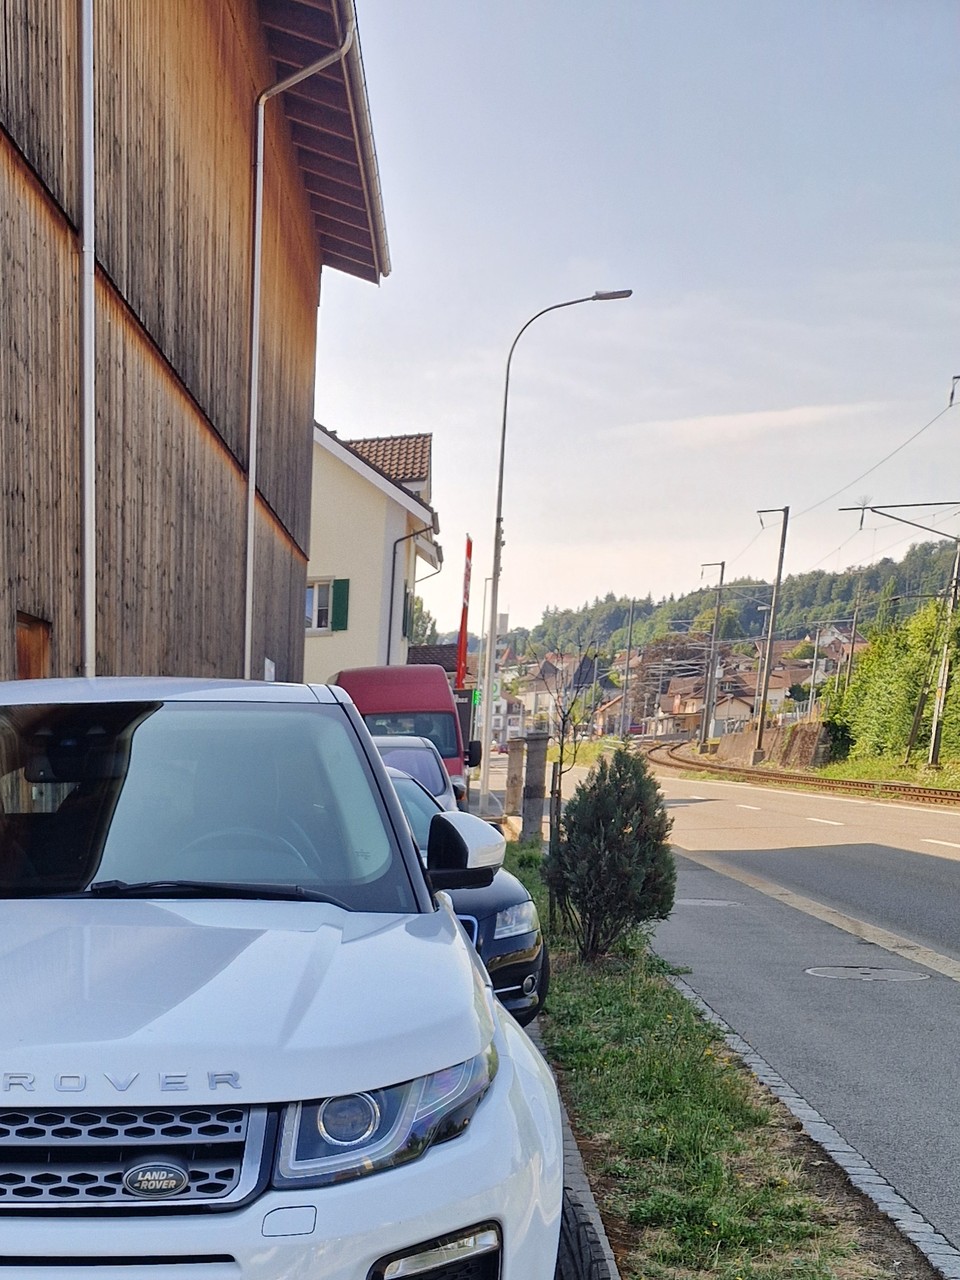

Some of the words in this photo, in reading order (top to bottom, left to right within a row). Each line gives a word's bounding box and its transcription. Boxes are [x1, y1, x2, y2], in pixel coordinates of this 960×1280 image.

[3, 1070, 242, 1093] ROVER
[137, 1171, 167, 1181] LAND
[140, 1180, 177, 1190] ROVER
